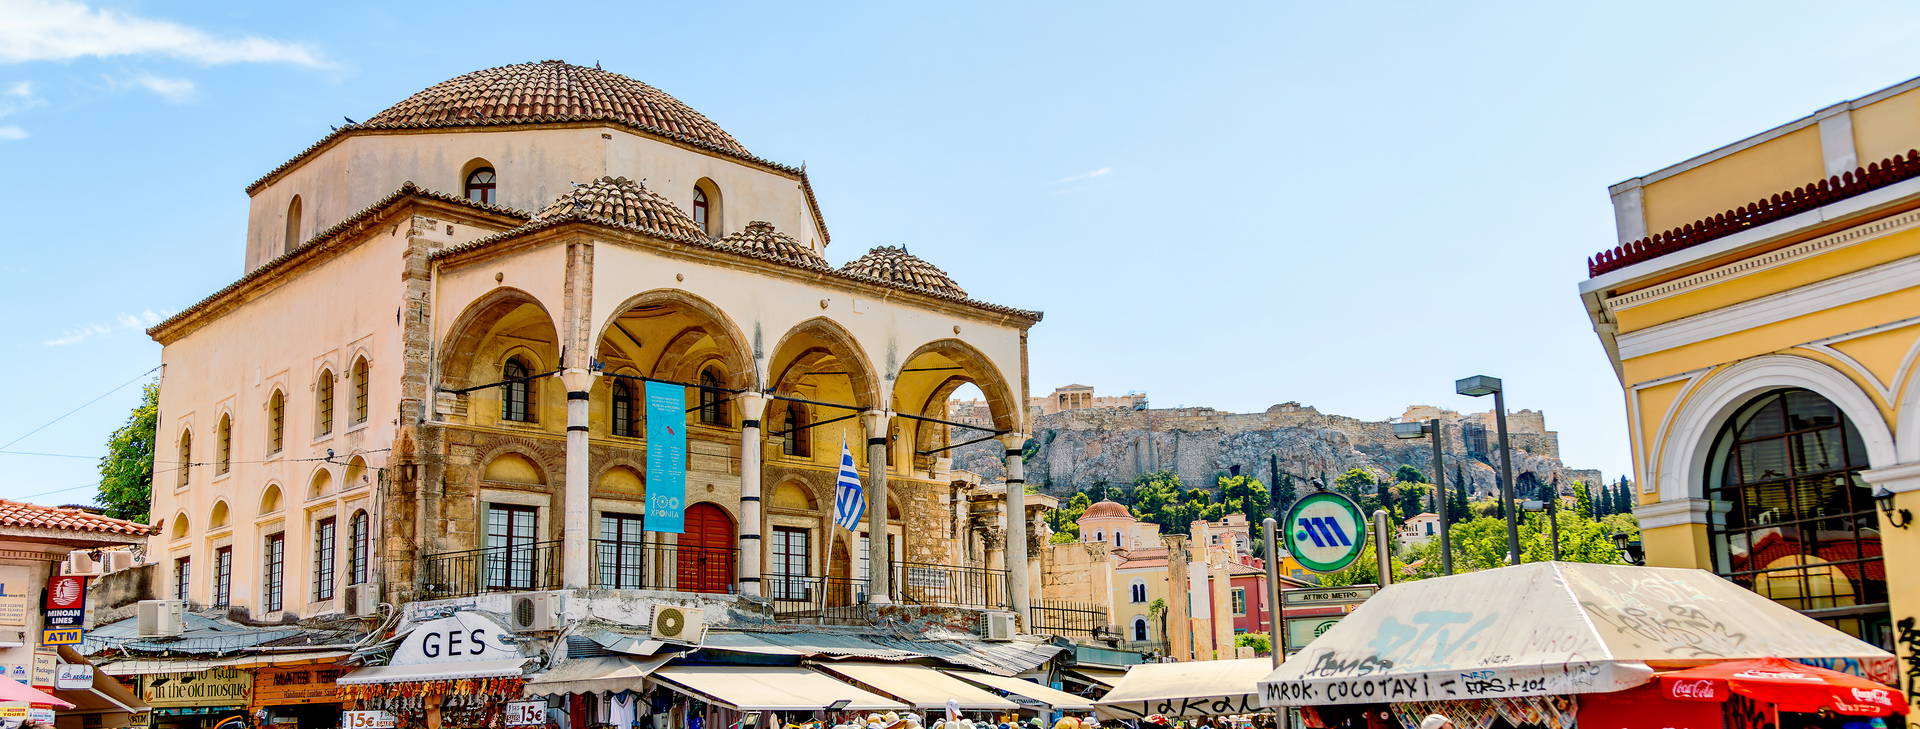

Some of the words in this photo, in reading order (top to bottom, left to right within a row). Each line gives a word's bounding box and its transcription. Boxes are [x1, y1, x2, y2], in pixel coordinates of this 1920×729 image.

[47, 609, 80, 617] MINOAN
[47, 630, 78, 642] ATM
[422, 628, 486, 658] GES
[155, 686, 165, 698] in
[168, 685, 186, 698] the
[187, 683, 205, 697] old
[207, 683, 247, 698] mosque
[348, 712, 375, 728] 15€
[521, 705, 542, 721] 15€
